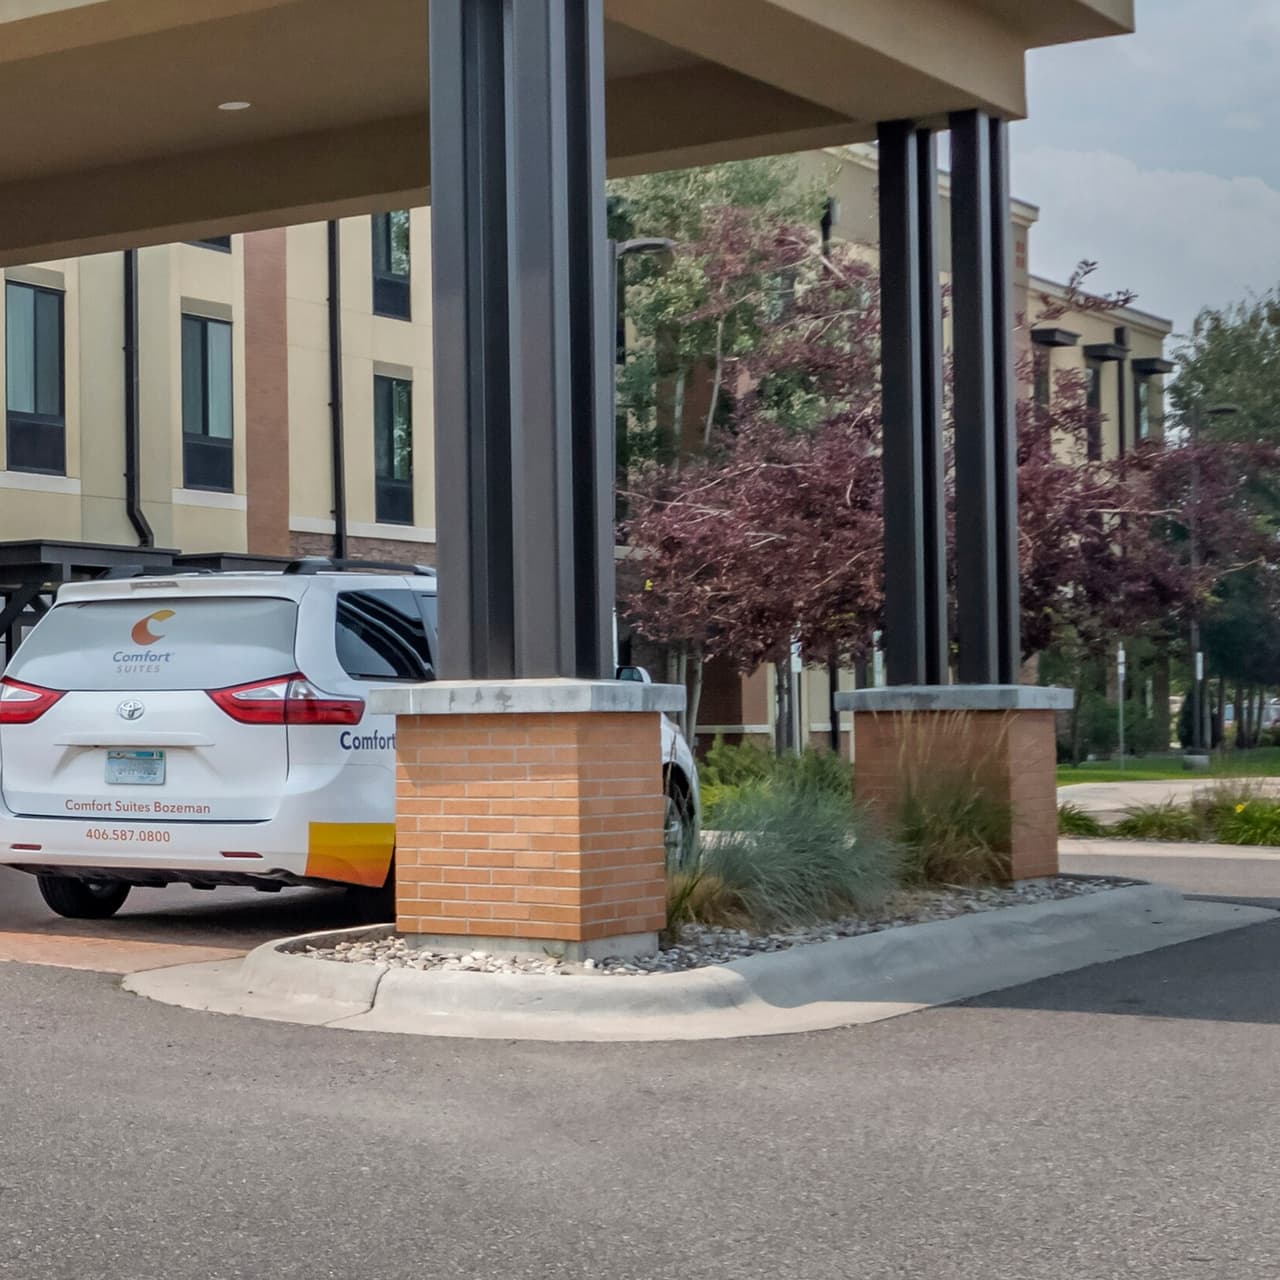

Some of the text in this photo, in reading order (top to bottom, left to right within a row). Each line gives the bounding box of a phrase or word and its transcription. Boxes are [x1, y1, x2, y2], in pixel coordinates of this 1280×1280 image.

[112, 650, 171, 663] Comfort
[116, 664, 161, 673] SUITES
[340, 729, 397, 750] Comfort
[65, 800, 211, 814] Comfort Suites Bozeman
[86, 828, 171, 843] 406.587.0800
